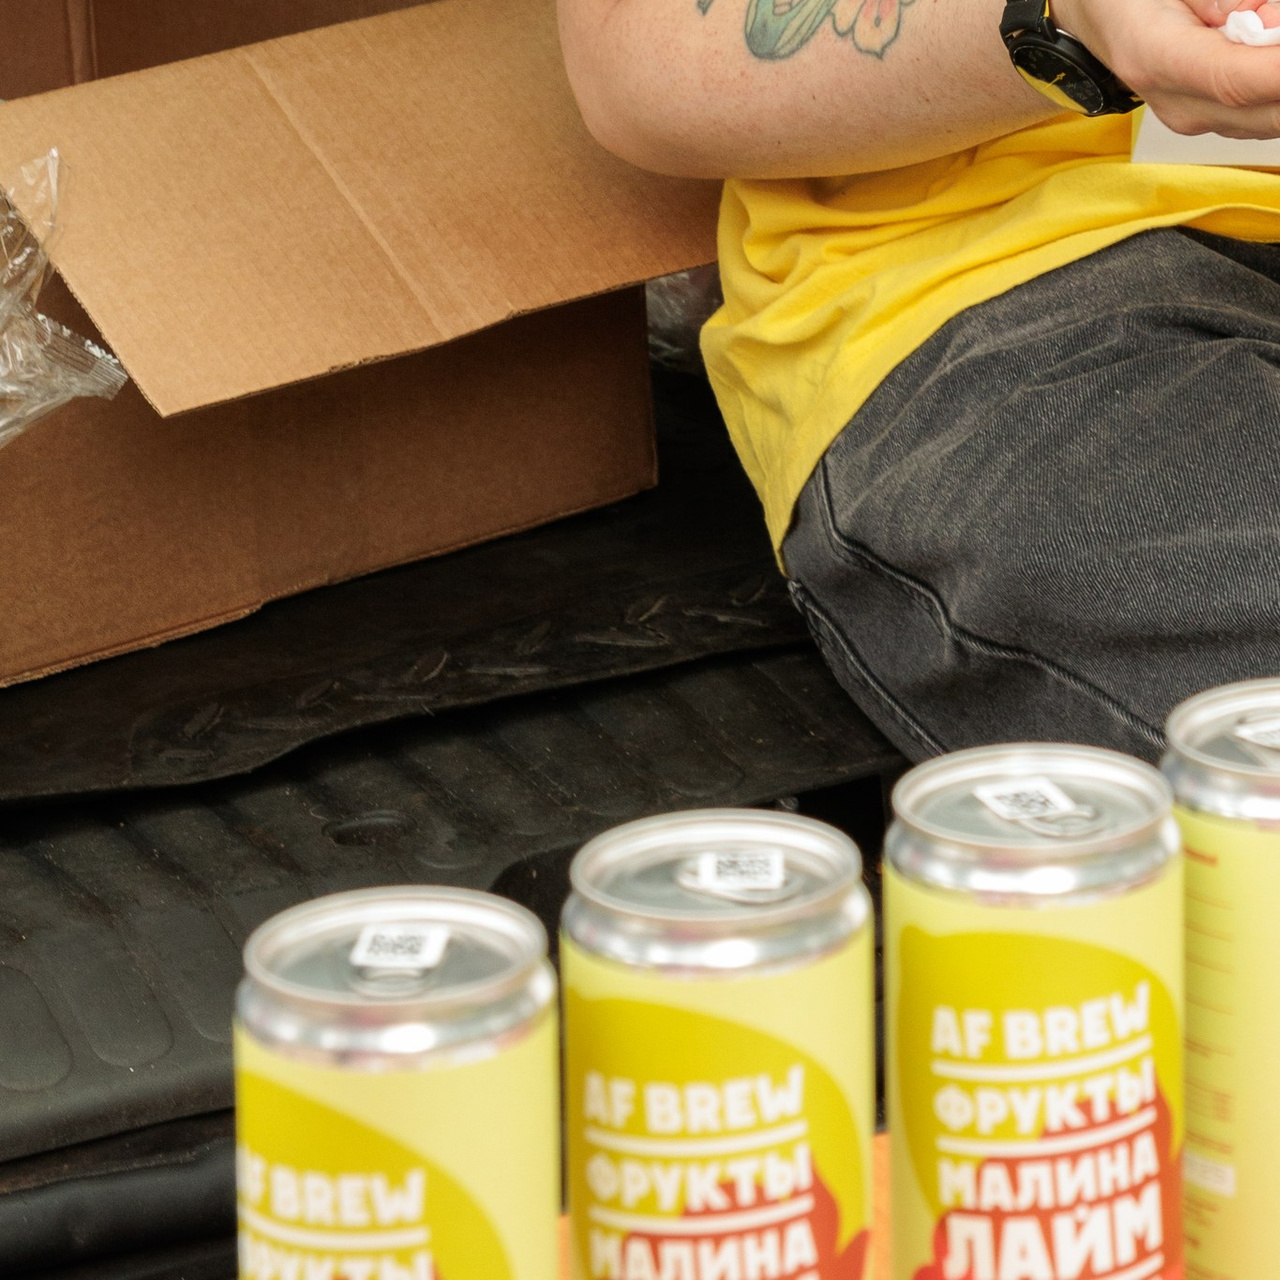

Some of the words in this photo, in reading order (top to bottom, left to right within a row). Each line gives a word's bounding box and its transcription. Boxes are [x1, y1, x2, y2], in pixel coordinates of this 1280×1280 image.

[930, 1005, 993, 1060] AF
[1003, 981, 1150, 1060] BREW
[584, 1069, 636, 1129] AF
[644, 1062, 805, 1134] BREW
[933, 1056, 1155, 1135] ФРУКТЫ
[270, 1162, 426, 1227] BREW
[584, 1141, 813, 1213] ФРУКТЫ
[936, 1130, 1160, 1211] МАЛИНА
[589, 1217, 818, 1280] МАЛИНА
[943, 1179, 1164, 1280] ЛАЙМ
